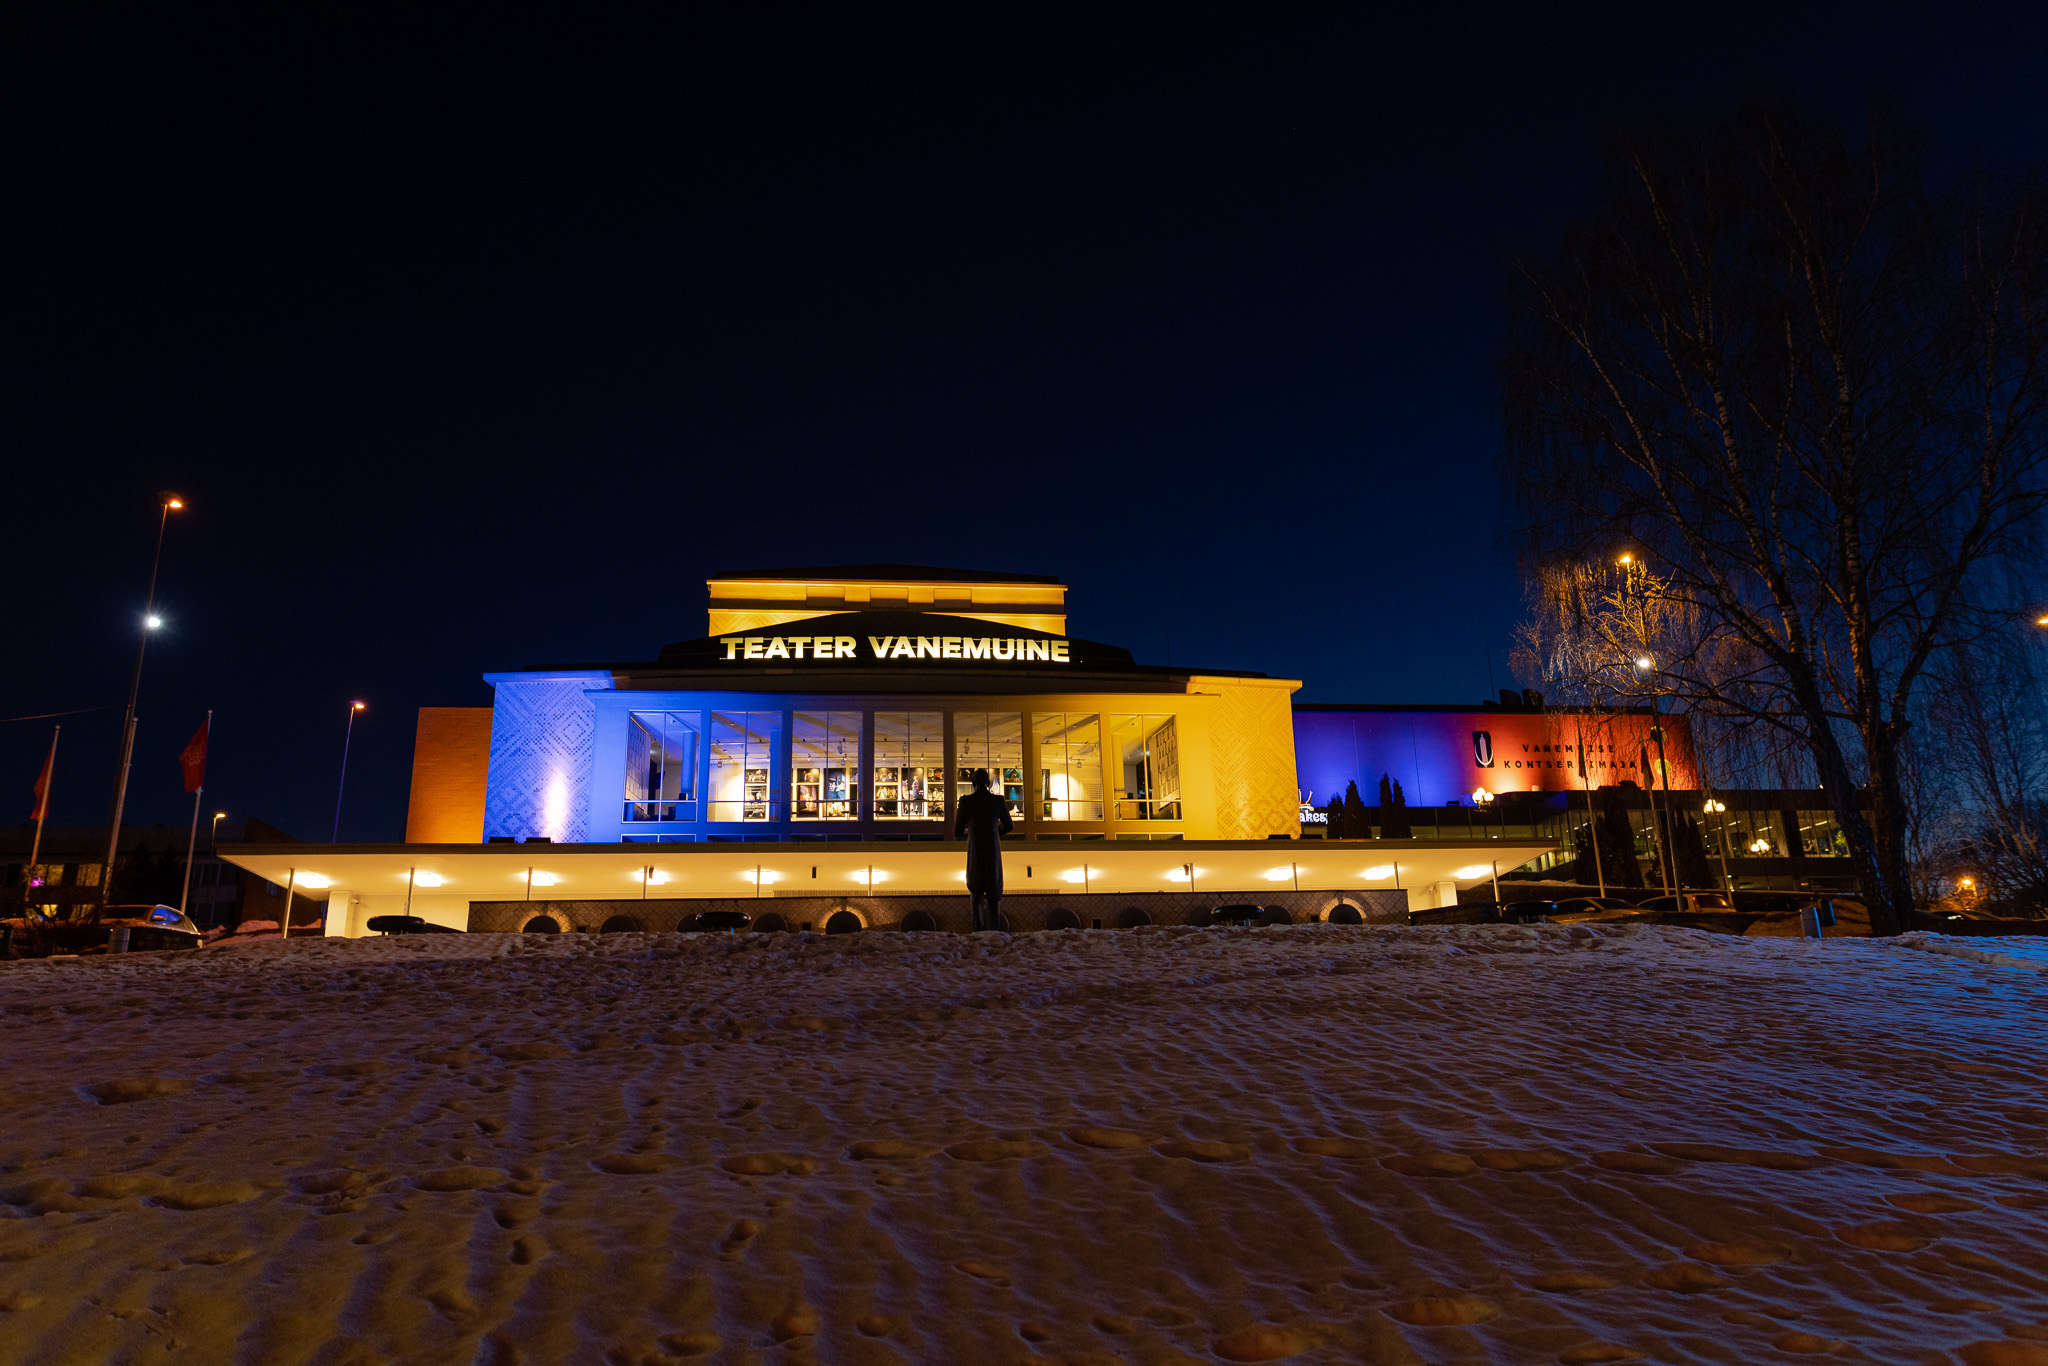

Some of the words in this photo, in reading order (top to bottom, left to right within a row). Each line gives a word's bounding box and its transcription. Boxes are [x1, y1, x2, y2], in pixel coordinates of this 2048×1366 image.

[720, 636, 857, 660] TEATER
[868, 636, 1070, 662] VANEMUINE
[1522, 744, 1615, 753] VANEMISE
[1503, 760, 1638, 769] KONTSERIMAJA
